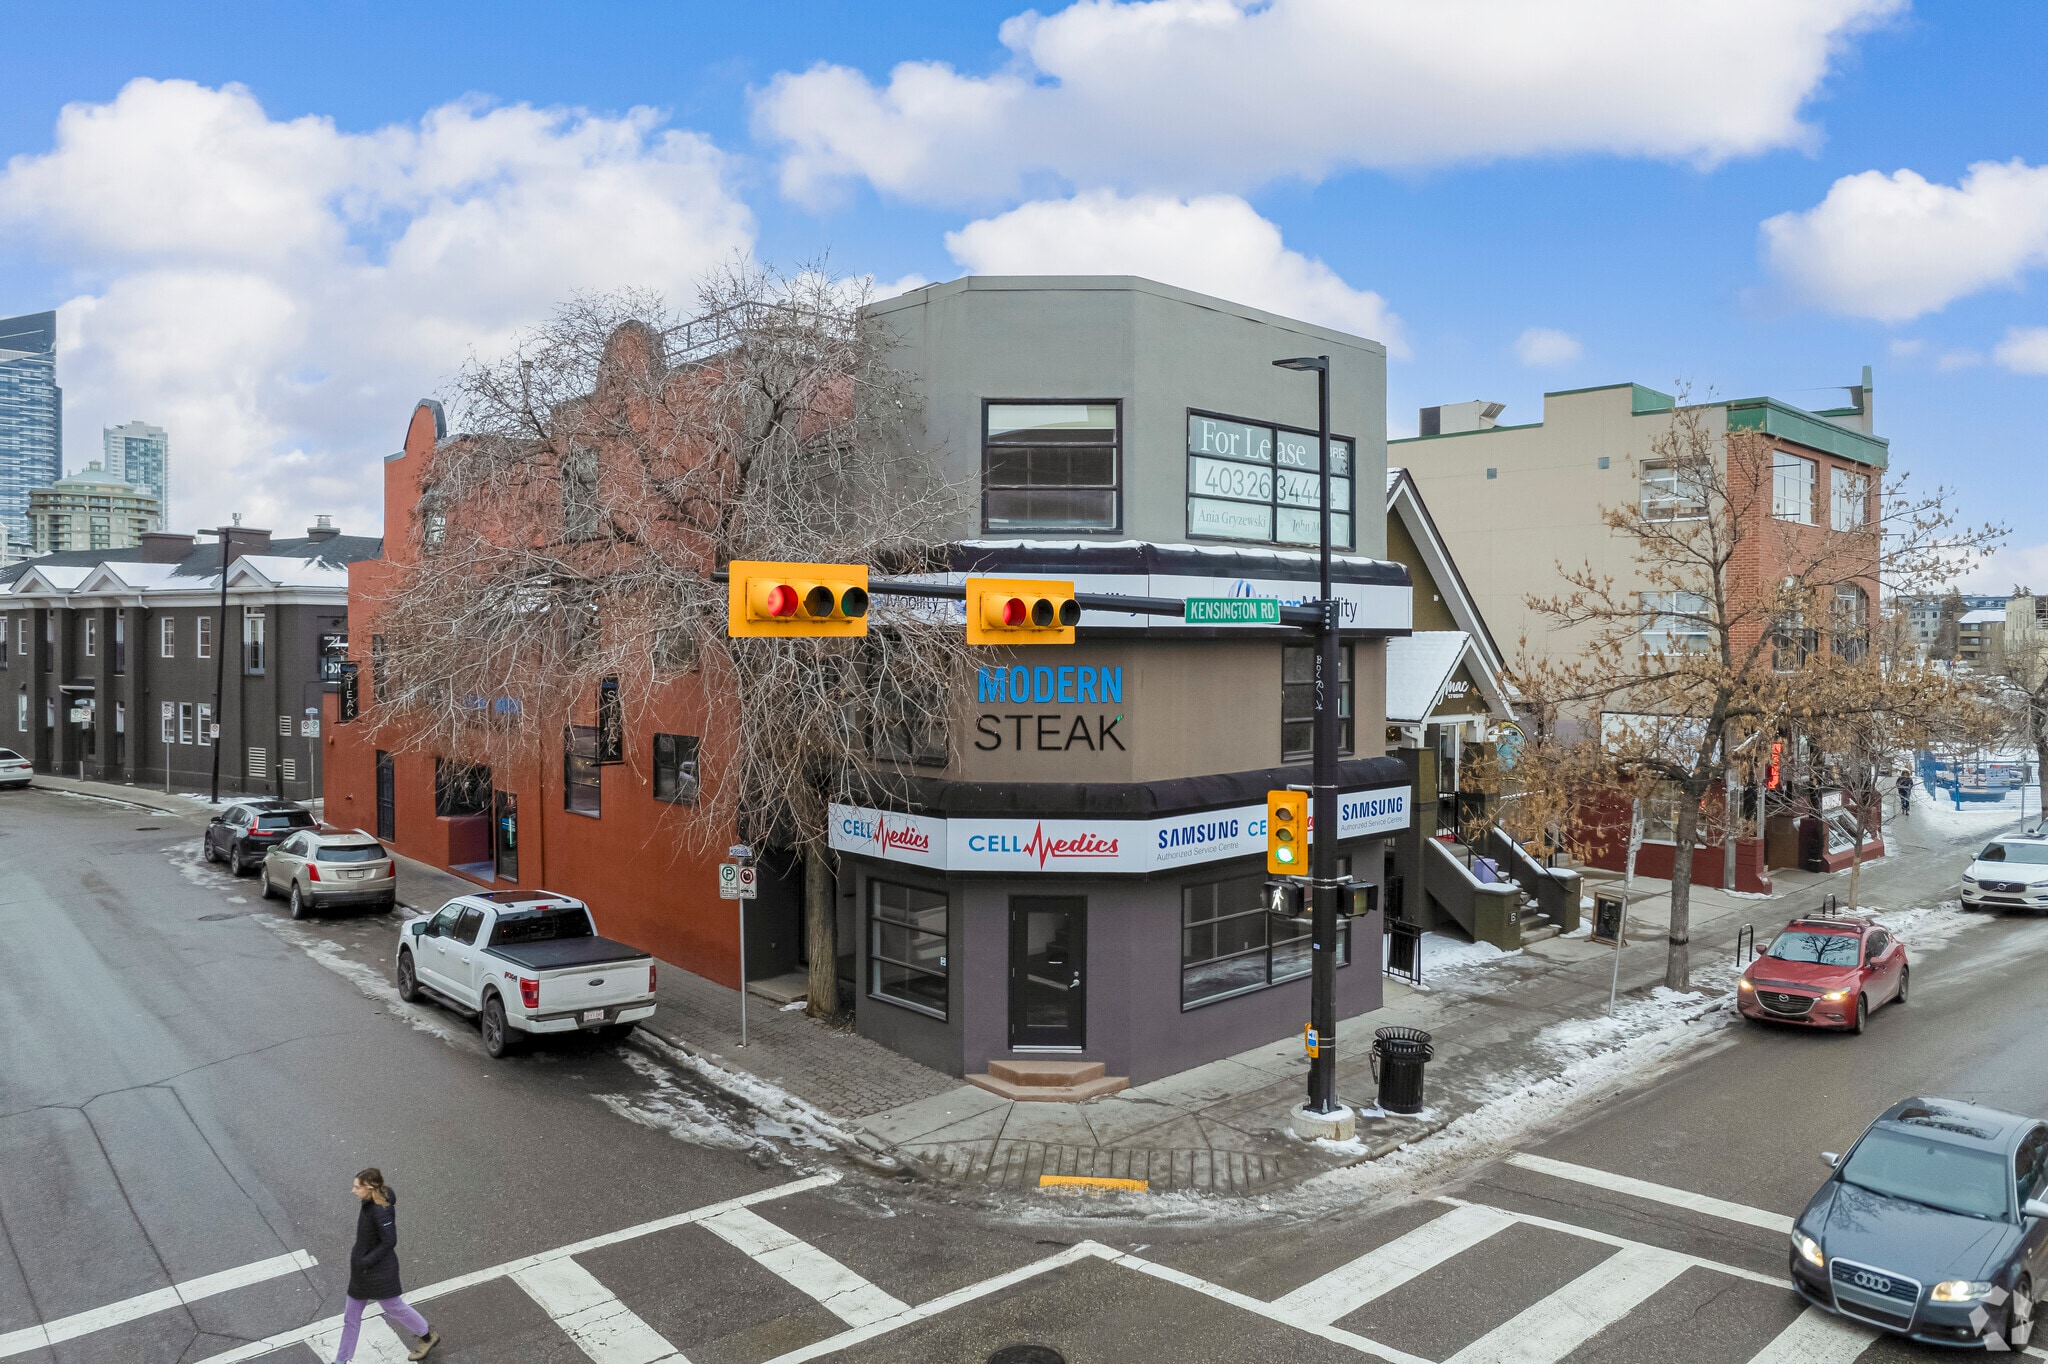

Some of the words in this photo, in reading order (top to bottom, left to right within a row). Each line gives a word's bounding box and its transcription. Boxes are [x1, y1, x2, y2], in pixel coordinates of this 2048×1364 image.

[1200, 420, 1239, 455] For
[1244, 428, 1306, 466] Lease
[1199, 509, 1220, 525] Ania
[1221, 511, 1267, 529] Gryzewski
[1190, 602, 1257, 620] KENSINGTON
[1261, 603, 1275, 619] RD
[346, 672, 354, 717] STEAK
[978, 665, 1123, 703] MODERN
[974, 714, 1126, 751] STEAK
[1342, 796, 1403, 821] SAMSUNG
[1158, 819, 1239, 849] SAMSUNG
[1248, 819, 1267, 837] CE
[1340, 820, 1370, 832] Authorized
[1370, 818, 1387, 828] Service
[1387, 815, 1403, 825] Centre
[1156, 849, 1199, 862] Authorized
[1199, 845, 1218, 857] Service
[1218, 842, 1239, 853] Centre
